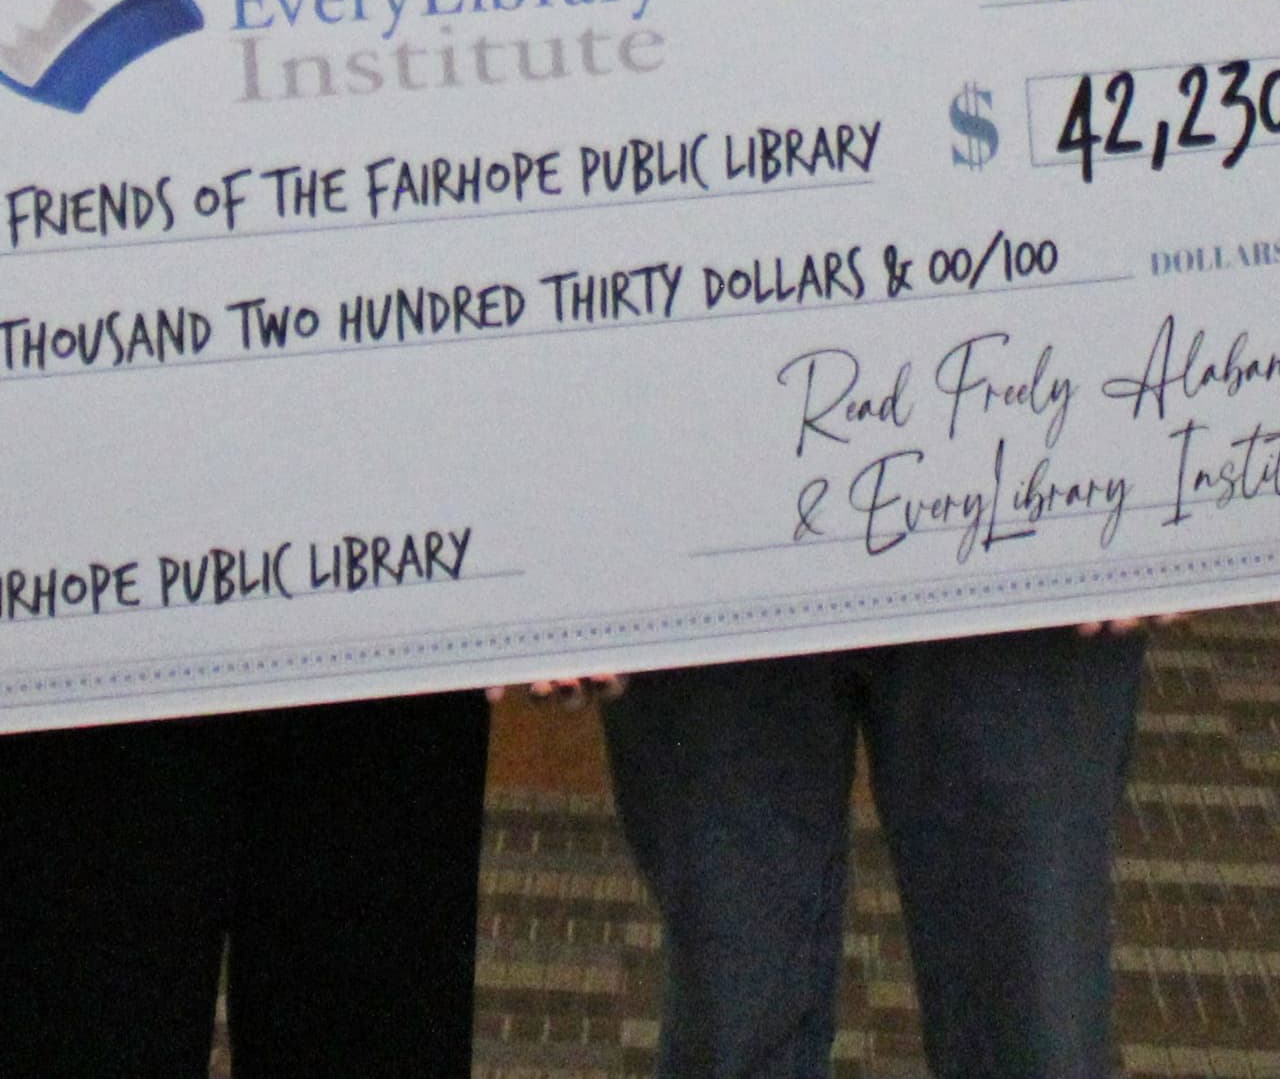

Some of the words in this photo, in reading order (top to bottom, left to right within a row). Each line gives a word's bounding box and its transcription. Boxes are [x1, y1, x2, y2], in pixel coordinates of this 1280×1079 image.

[232, 24, 667, 104] Institute
[5, 175, 177, 249] FRIENDS
[193, 167, 254, 230] OF
[260, 165, 348, 218] THE
[365, 151, 563, 219] FAIRHOPE
[580, 133, 710, 194] PUBLIC
[724, 121, 882, 182] LIBRARY
[949, 81, 1000, 173] $
[225, 296, 322, 351] TWO
[338, 283, 527, 343] HUNDRED
[539, 262, 683, 324] THIRTY
[701, 245, 867, 311] DOLLARS
[883, 244, 914, 296] &
[926, 229, 1059, 290] 00/100
[776, 347, 915, 459] Read
[934, 331, 1080, 447] Freely
[792, 478, 830, 542] &
[848, 437, 1134, 567] EveryLibrary
[159, 540, 296, 607] PUBLIC
[307, 526, 472, 591] LIBRARY
